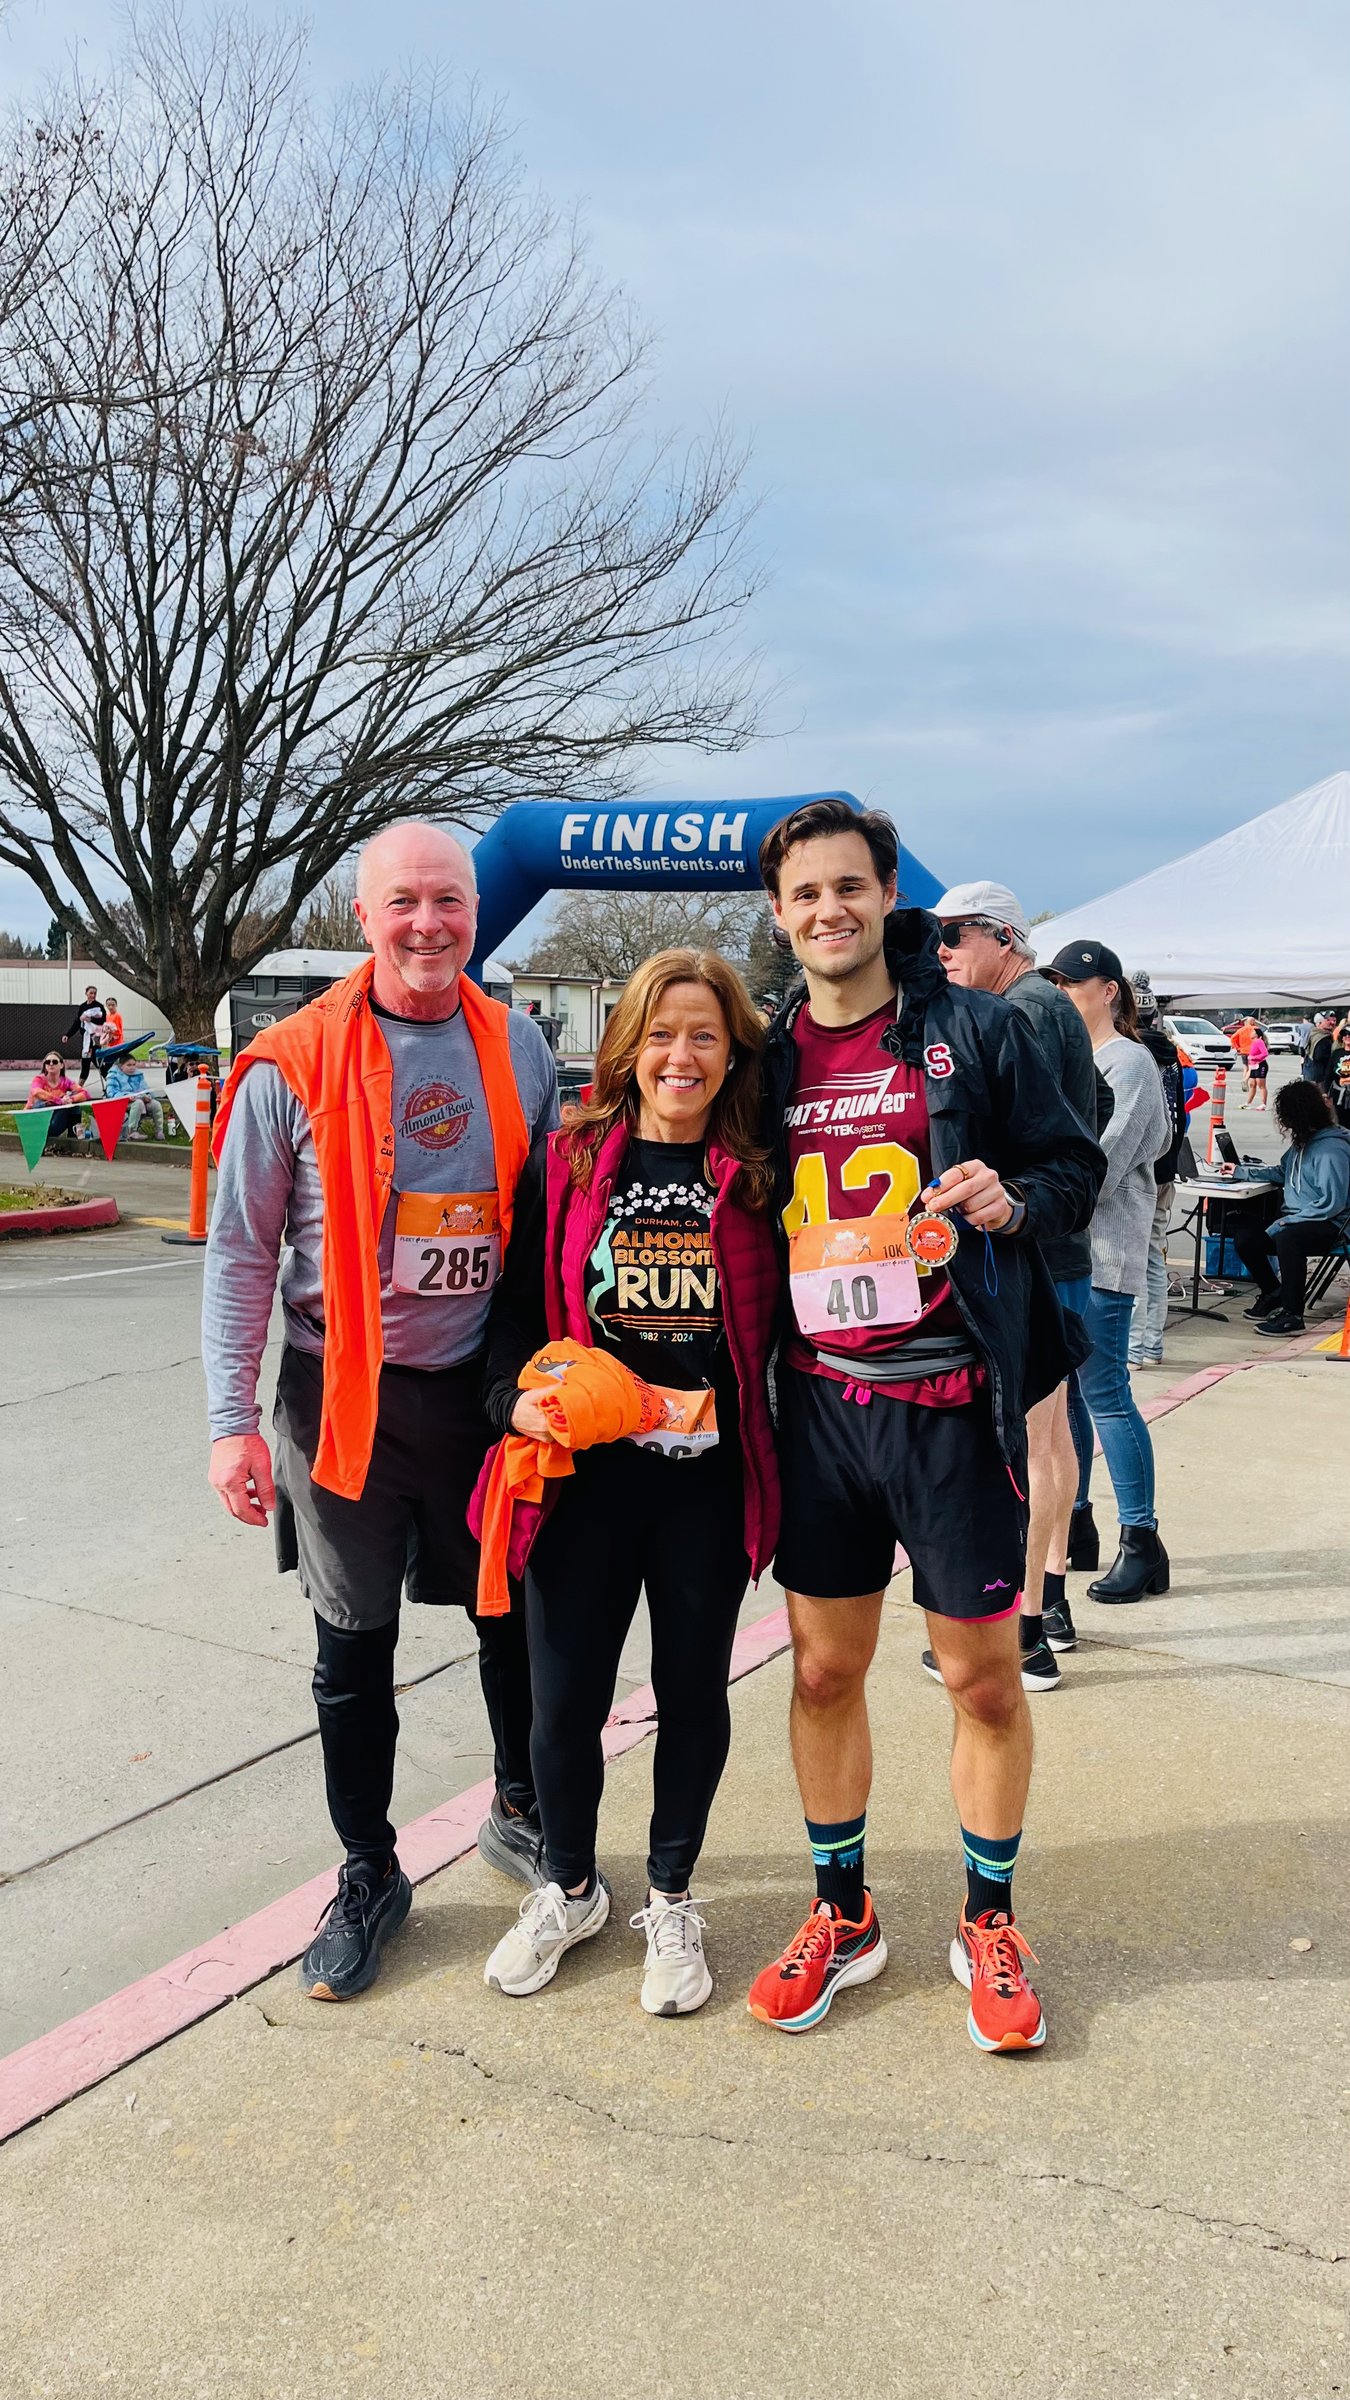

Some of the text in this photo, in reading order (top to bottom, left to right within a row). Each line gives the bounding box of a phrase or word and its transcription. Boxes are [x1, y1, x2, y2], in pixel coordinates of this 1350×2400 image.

[560, 812, 748, 852] FINISH
[561, 855, 745, 873] UnderTheSunEvents.org
[924, 1042, 955, 1079] S
[399, 1109, 446, 1138] Almond
[445, 1097, 474, 1118] Bowl
[783, 1098, 833, 1128] PAT'S
[831, 1091, 882, 1121] RUN
[832, 1123, 885, 1137] TEKsystems
[782, 1142, 922, 1230] 42
[635, 1217, 682, 1227] DURHAM,
[418, 1245, 490, 1290] 285
[614, 1249, 715, 1266] BLOSSOM
[883, 1243, 904, 1259] 10K
[617, 1266, 716, 1309] RUN
[827, 1275, 878, 1323] 40
[639, 1332, 694, 1342] 1982 2024
